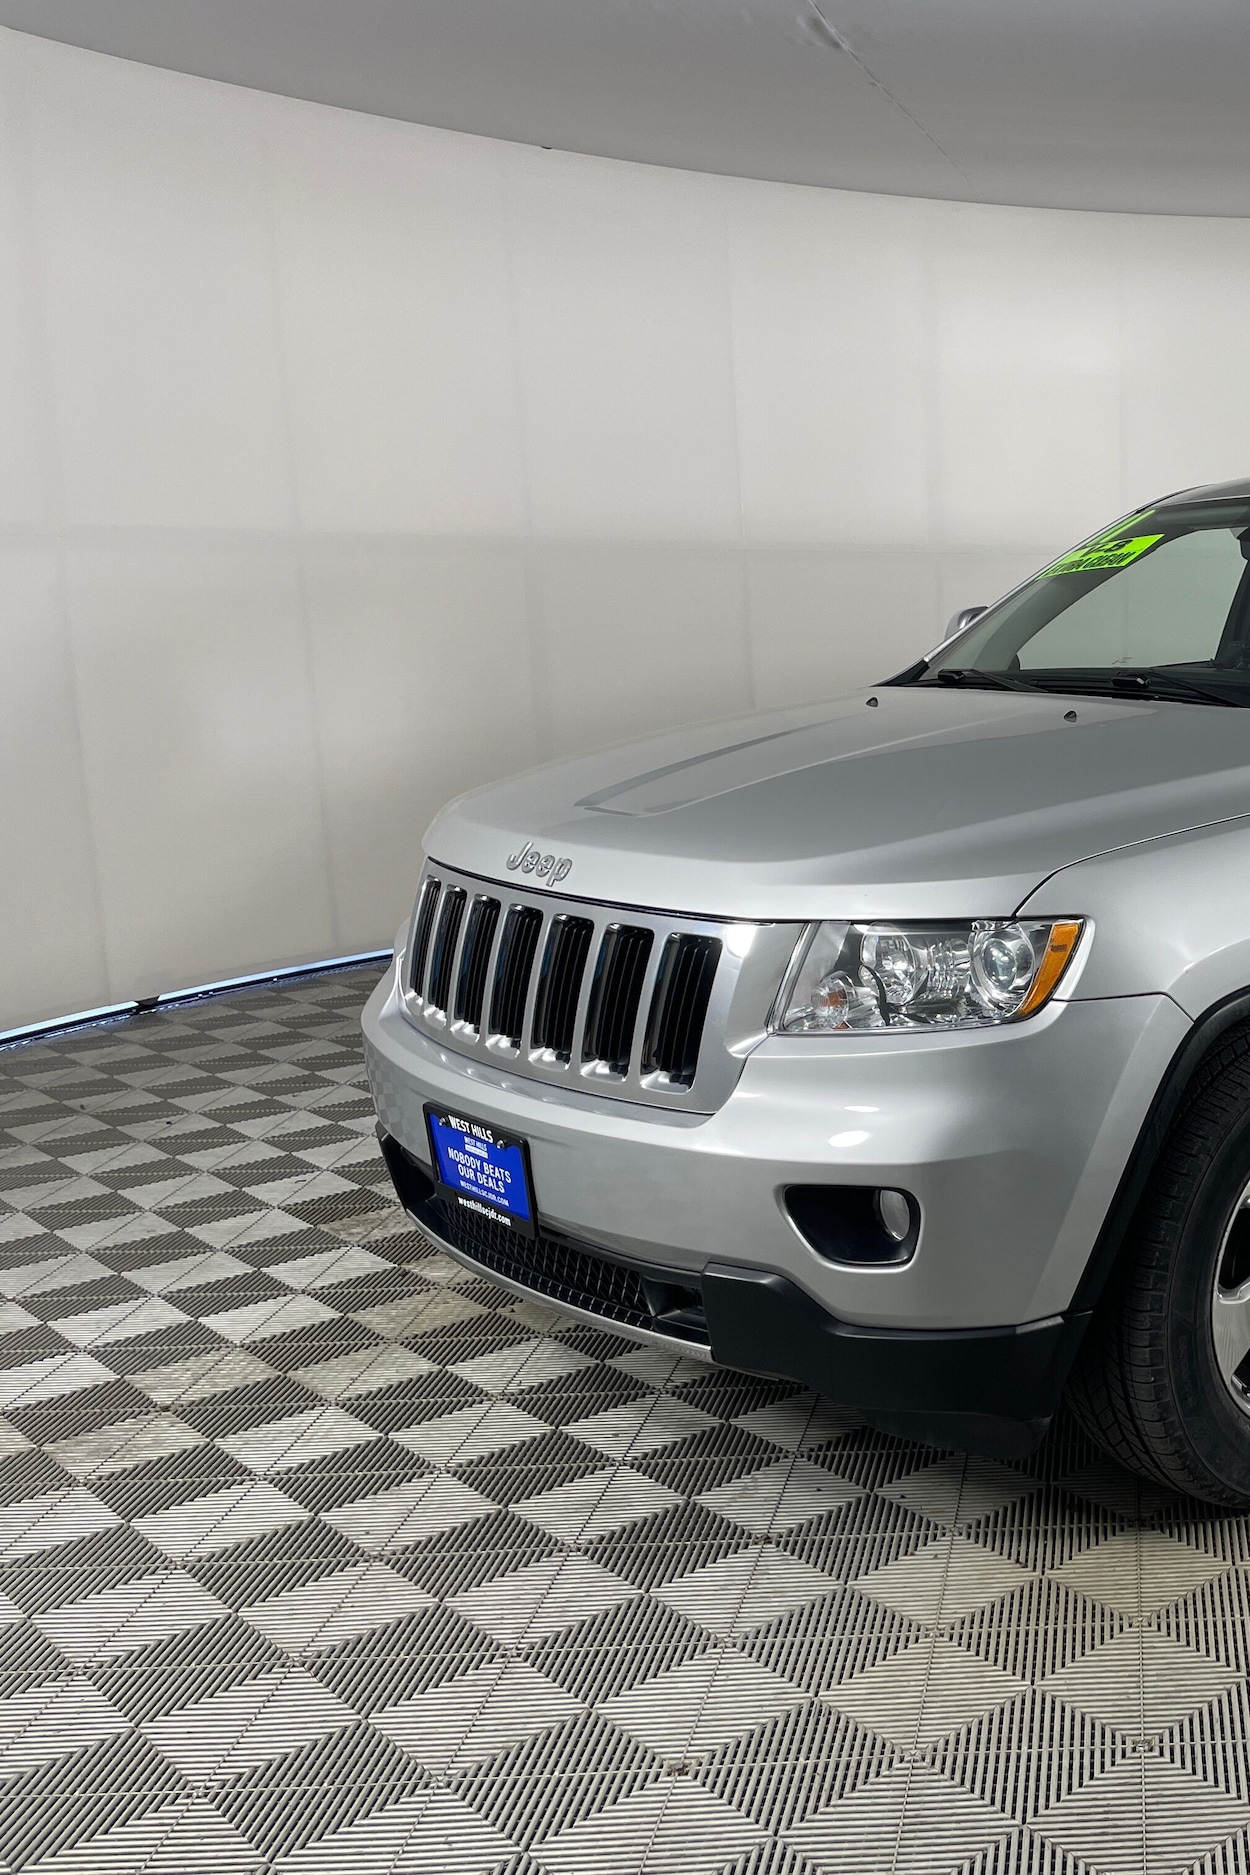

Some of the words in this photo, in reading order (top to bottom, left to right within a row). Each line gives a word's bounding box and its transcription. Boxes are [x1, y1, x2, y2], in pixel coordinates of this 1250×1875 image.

[506, 841, 573, 888] Jeep
[448, 1115, 471, 1134] WEST
[471, 1124, 493, 1143] HILLS
[464, 1136, 475, 1147] WEST
[447, 1146, 482, 1170] NOBODY
[482, 1161, 512, 1184] BEATS
[457, 1164, 476, 1183] OUR
[477, 1172, 505, 1194] DEALS
